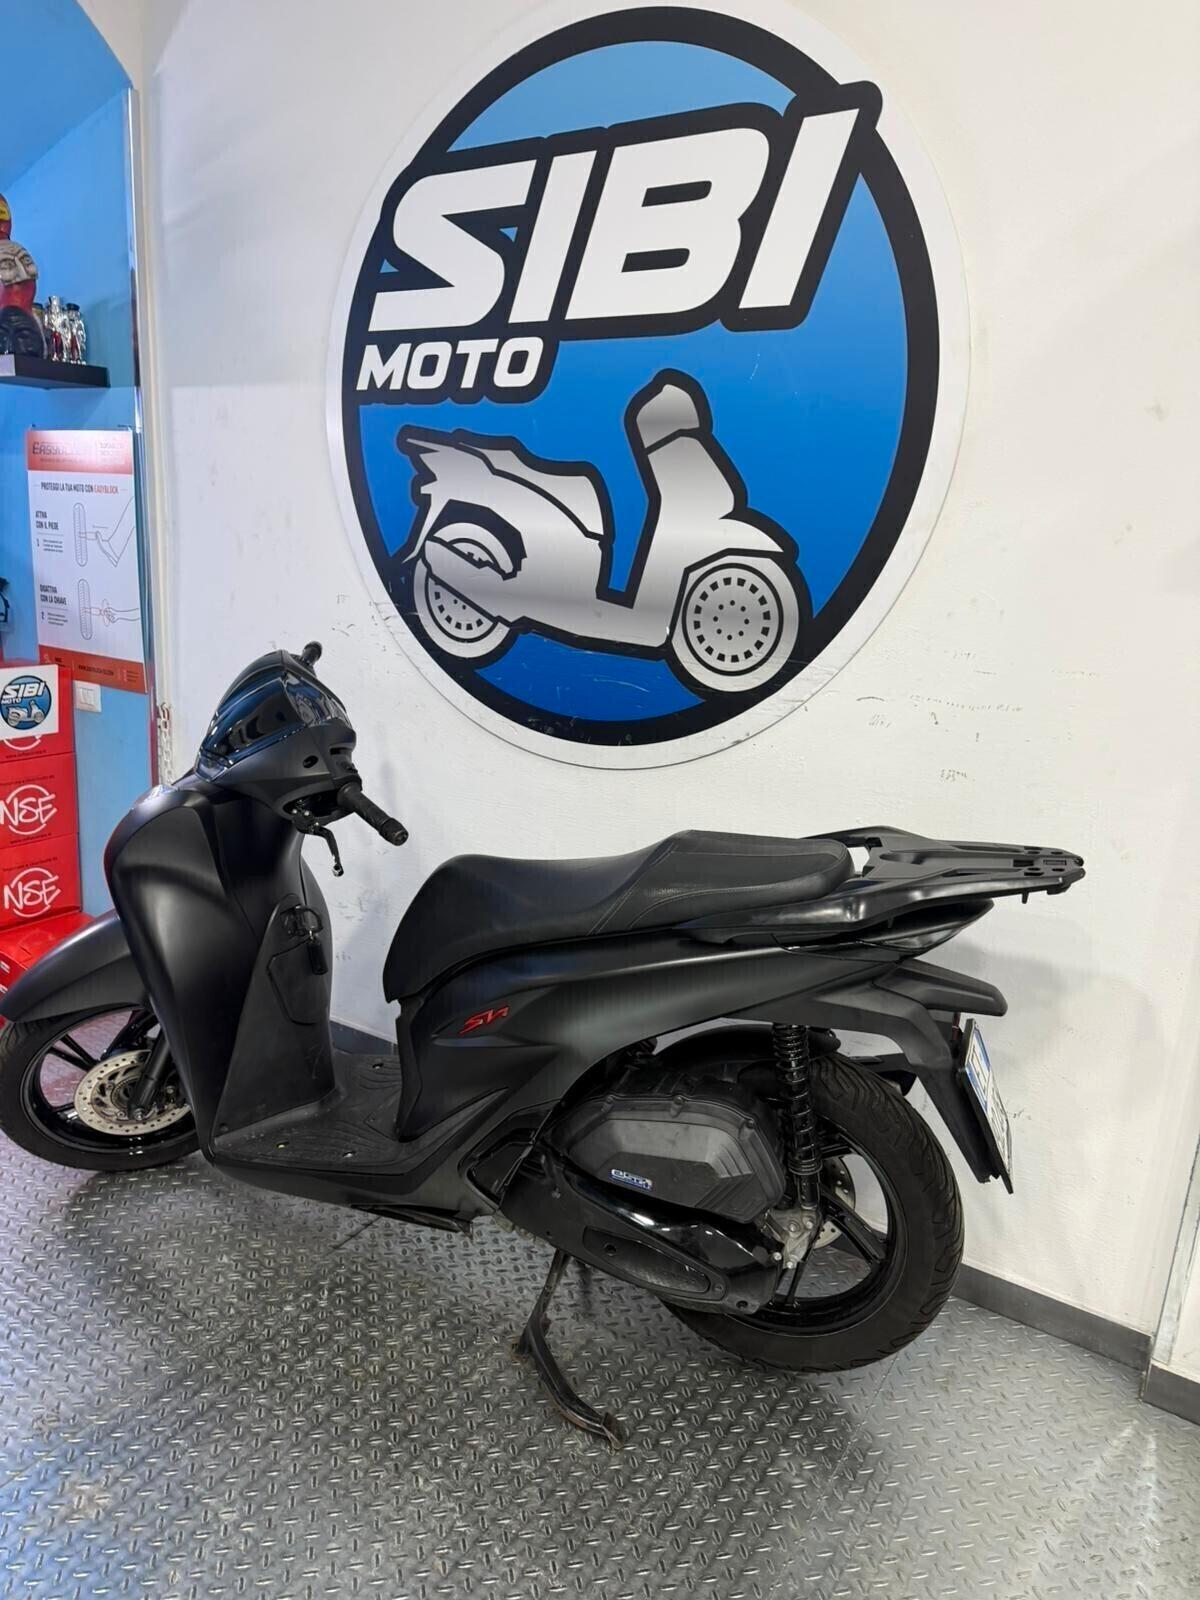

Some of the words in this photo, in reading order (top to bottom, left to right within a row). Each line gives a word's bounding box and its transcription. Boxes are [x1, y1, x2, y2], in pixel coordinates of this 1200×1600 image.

[368, 108, 859, 331] SIBI
[356, 337, 543, 390] MOTO
[2, 682, 45, 699] SIBI
[0, 793, 58, 827] NSE
[3, 874, 62, 910] NSE
